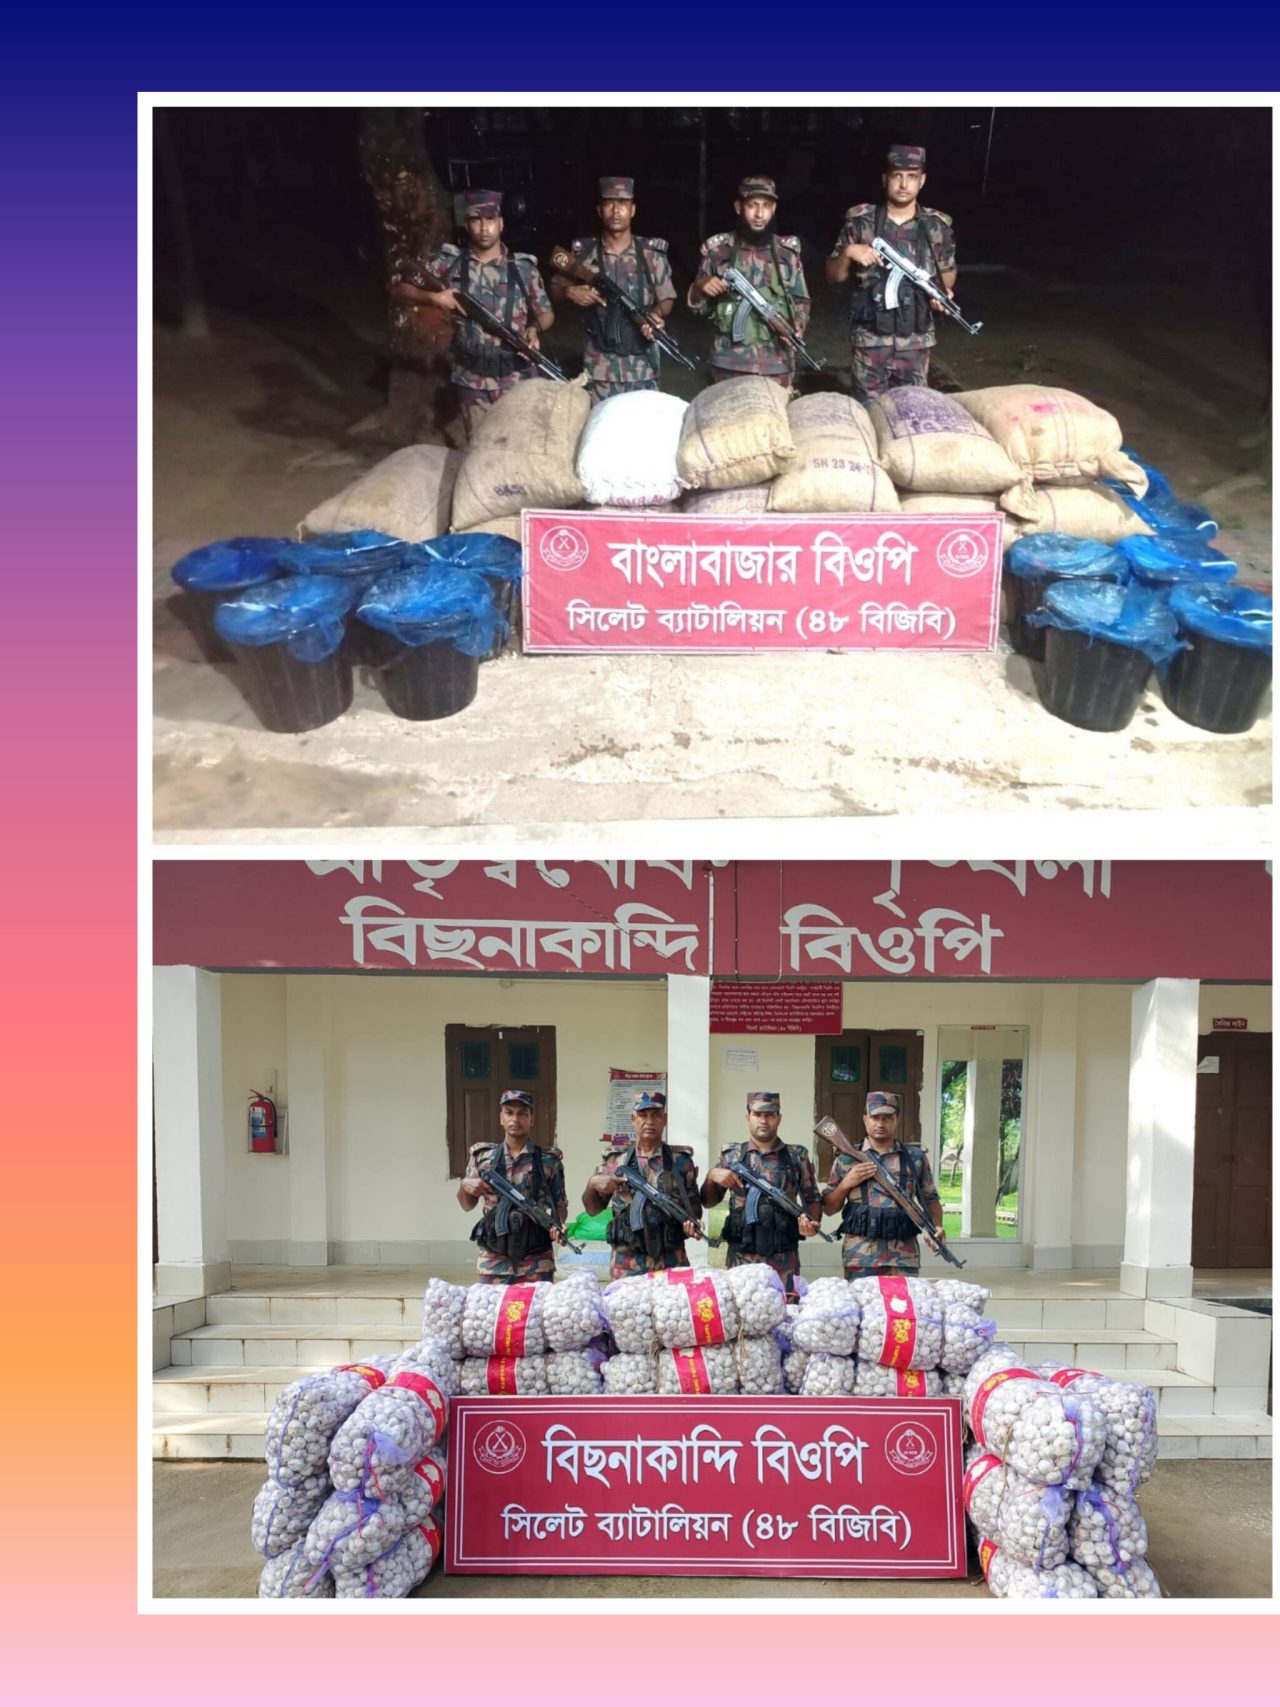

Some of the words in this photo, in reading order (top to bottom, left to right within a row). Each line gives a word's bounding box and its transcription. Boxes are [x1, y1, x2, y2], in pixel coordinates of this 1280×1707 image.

[607, 538, 801, 587] বাংলাবাজার
[811, 531, 918, 586] বিওপি
[567, 603, 649, 631] সিলেট
[656, 601, 787, 632] ব্যাটালিয়ন
[796, 607, 849, 639] (৪৮
[858, 602, 955, 640] বিজিবি)
[339, 896, 699, 970] বিছনাকান্দি
[779, 904, 1004, 974] বিওপি
[541, 1424, 743, 1488] বিছনাকান্দি
[751, 1425, 868, 1484] বিওপি
[501, 1504, 586, 1539] সিলেট
[595, 1503, 732, 1541] ব্যাটালিয়ন
[743, 1509, 798, 1548] (৪৮
[808, 1504, 911, 1550] বিজিবি)
